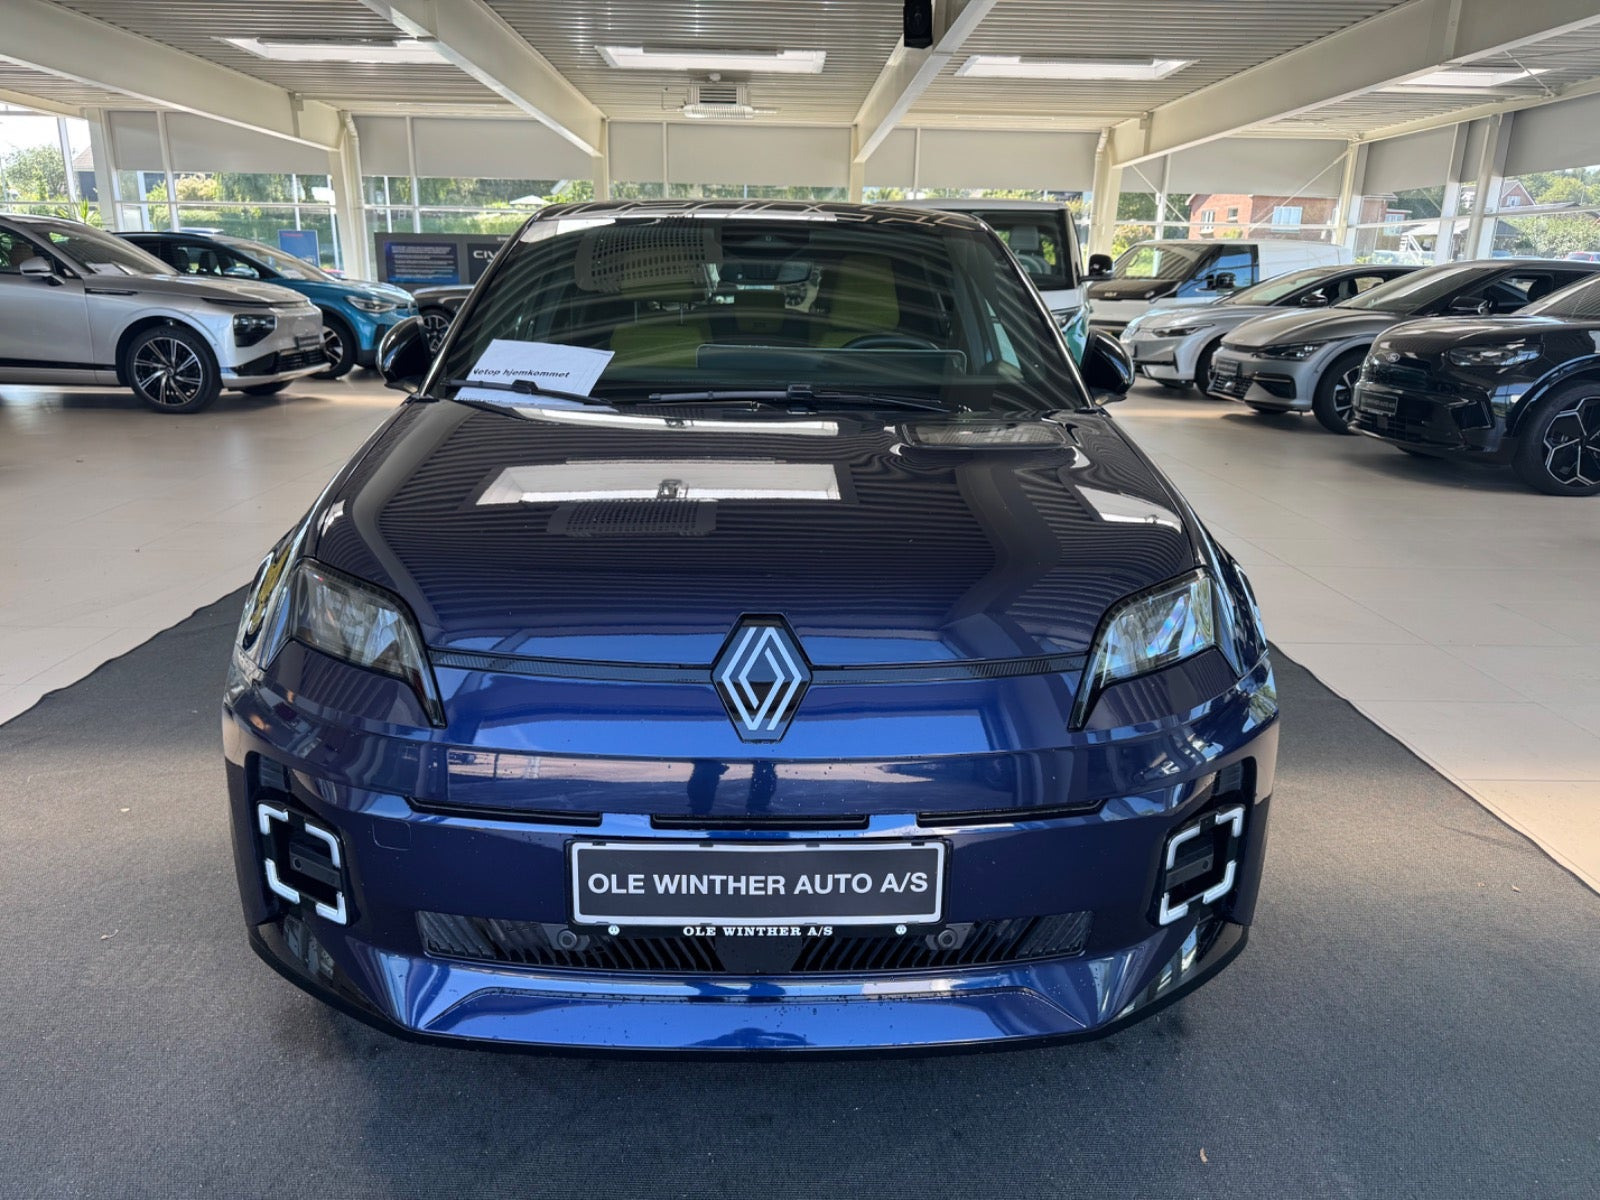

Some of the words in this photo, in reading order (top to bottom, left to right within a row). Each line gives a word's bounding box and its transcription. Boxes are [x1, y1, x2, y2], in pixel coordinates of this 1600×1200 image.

[502, 369, 570, 378] hjemkommet
[588, 873, 645, 894] OLE
[652, 874, 786, 895] WINTHER
[794, 873, 873, 895] AUTO
[880, 872, 929, 893] A/S
[682, 926, 717, 937] OLE
[722, 926, 802, 937] WINTHER
[807, 926, 834, 937] A/S
